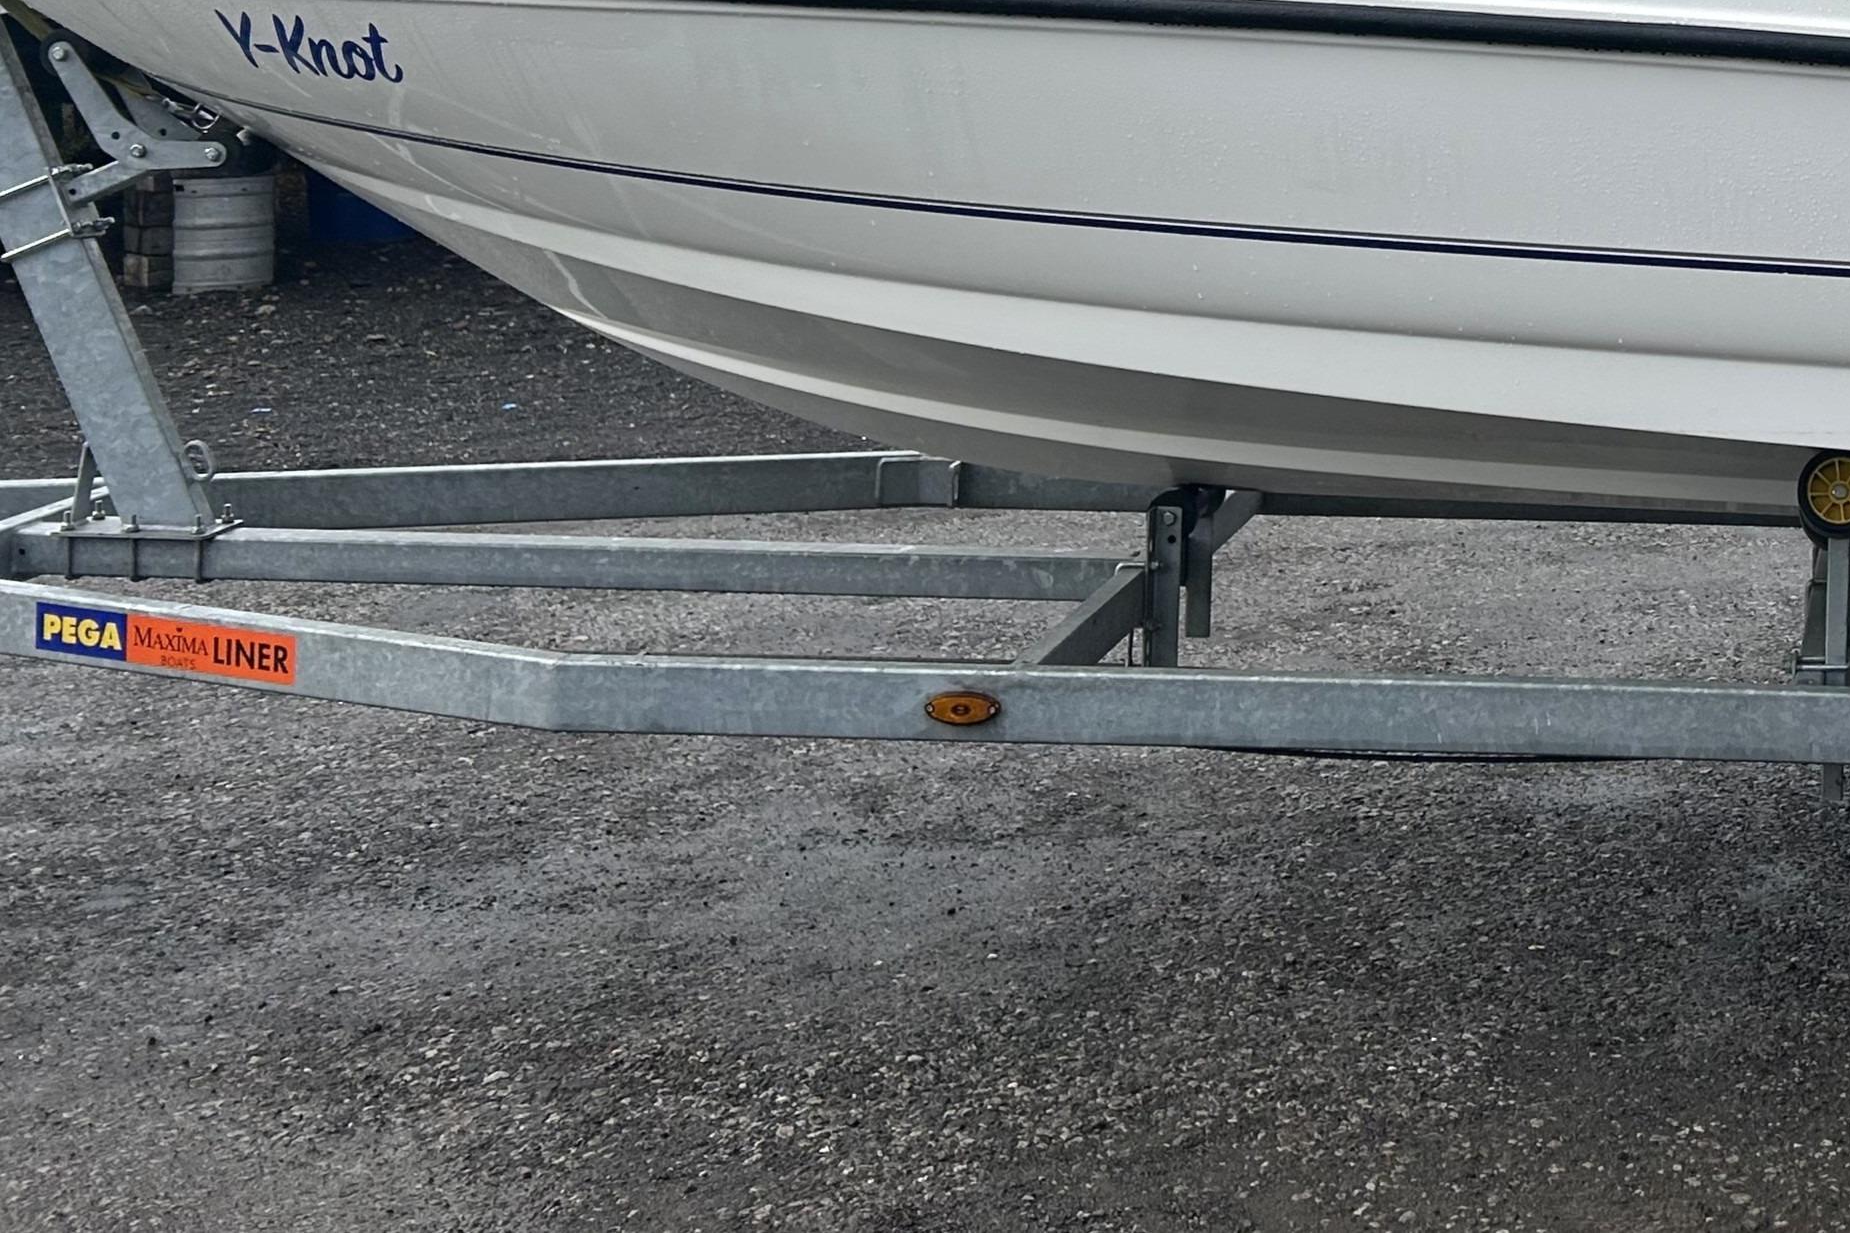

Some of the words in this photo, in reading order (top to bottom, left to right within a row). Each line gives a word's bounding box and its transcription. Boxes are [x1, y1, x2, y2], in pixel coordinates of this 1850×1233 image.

[214, 9, 403, 83] Y-Knot
[43, 613, 122, 651] PEGA
[133, 625, 208, 656] MAXIMA
[213, 636, 289, 675] LINER
[160, 655, 196, 671] BOATS
